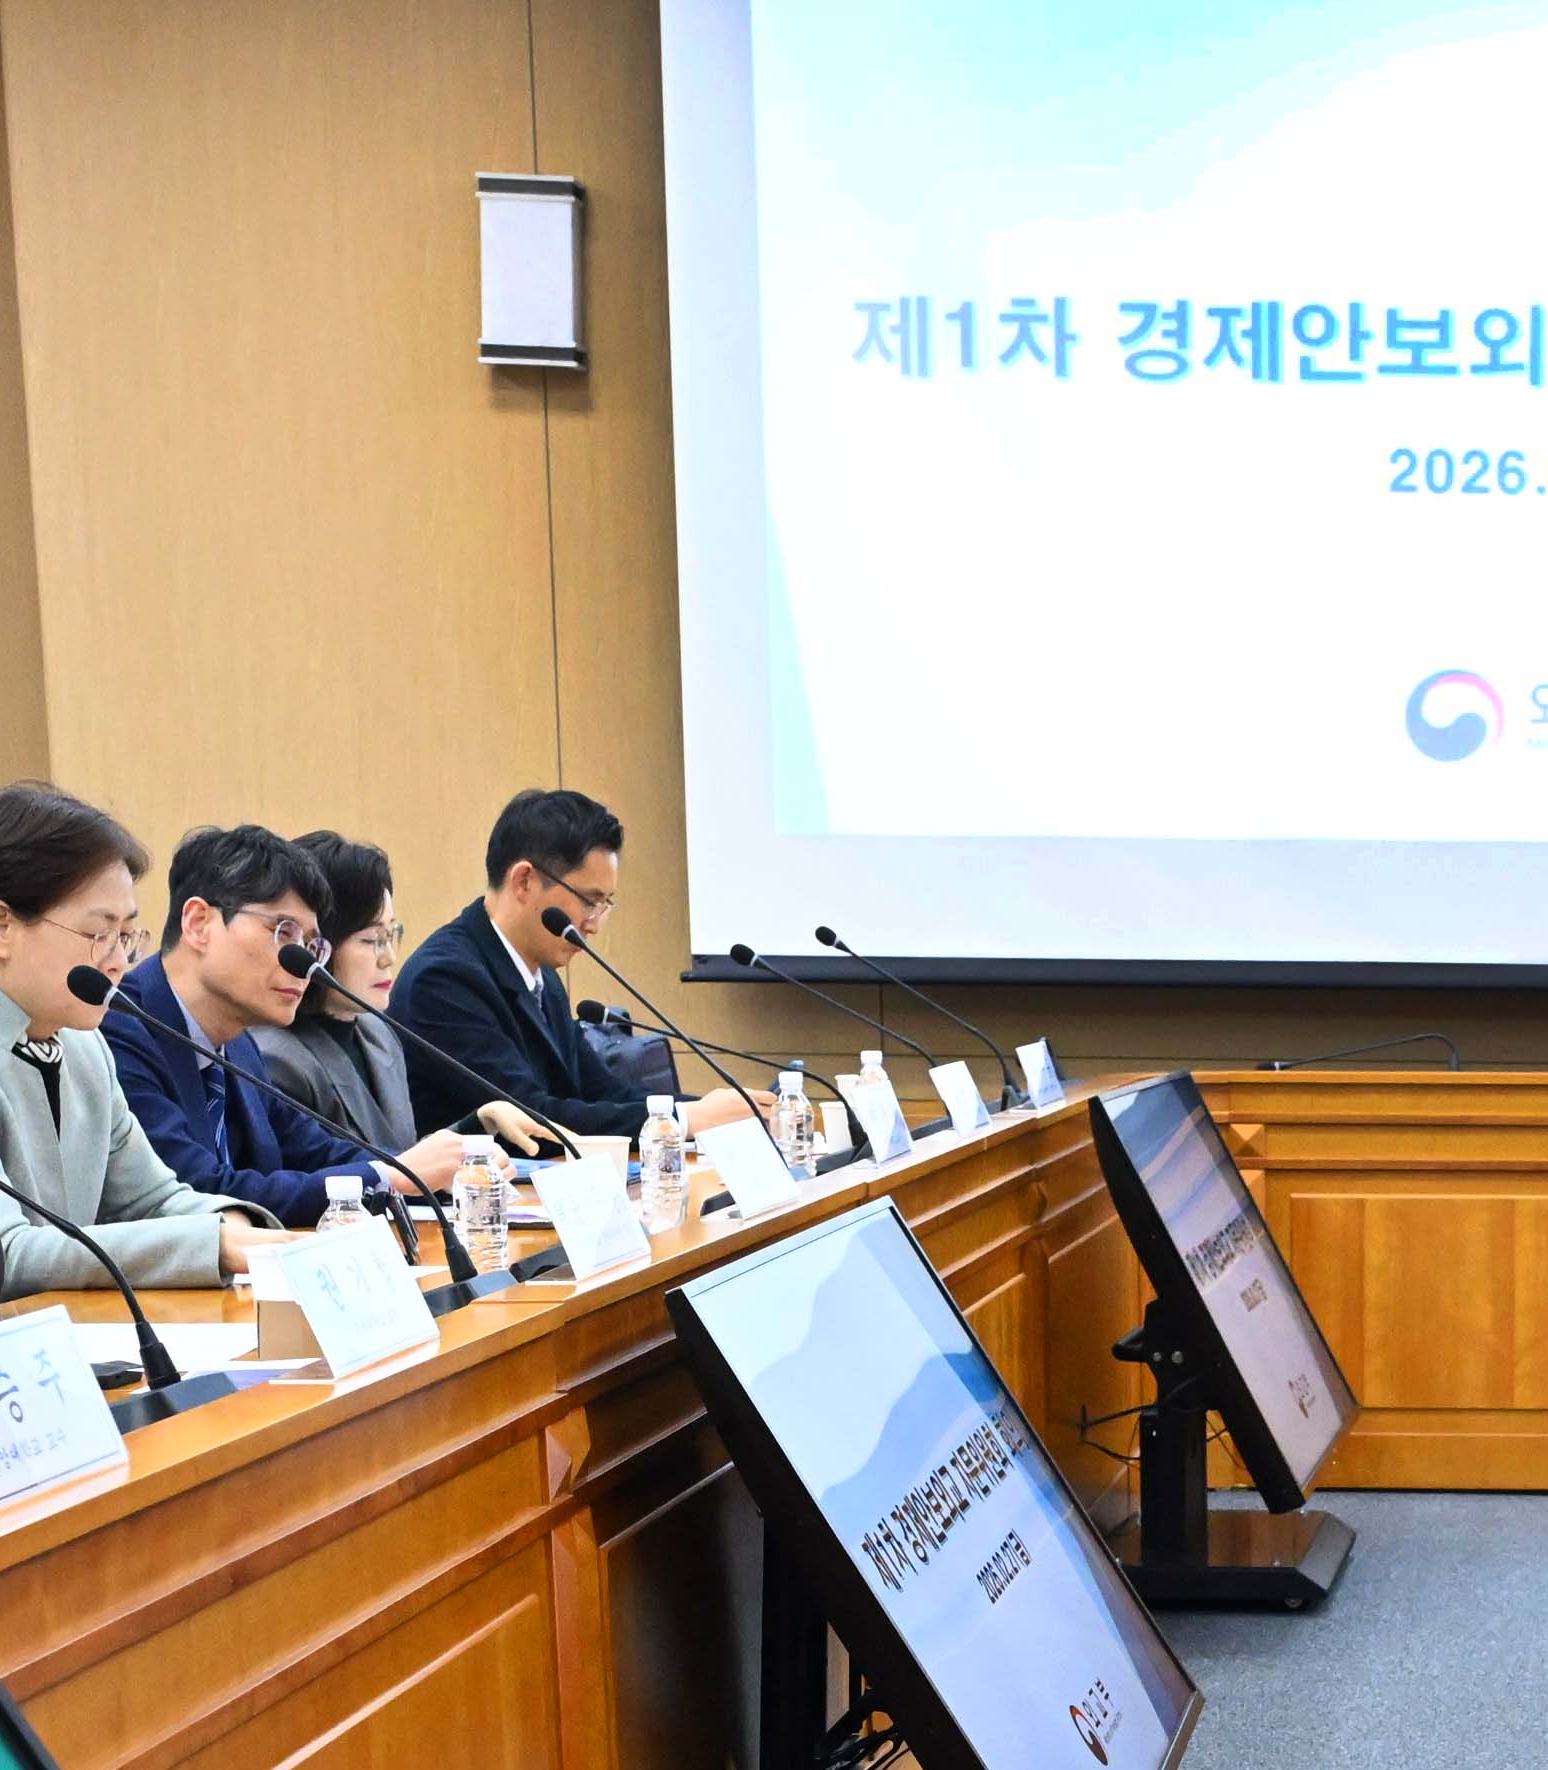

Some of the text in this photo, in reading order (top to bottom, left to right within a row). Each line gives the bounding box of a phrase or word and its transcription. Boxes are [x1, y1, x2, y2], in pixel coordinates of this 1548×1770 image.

[852, 296, 1078, 379] 제1차
[860, 1516, 918, 1593] 제1차
[890, 1464, 970, 1565] 경제안보외교
[949, 1420, 1015, 1503] 자문위원회
[976, 1527, 1032, 1604] 2026.02.27(금)
